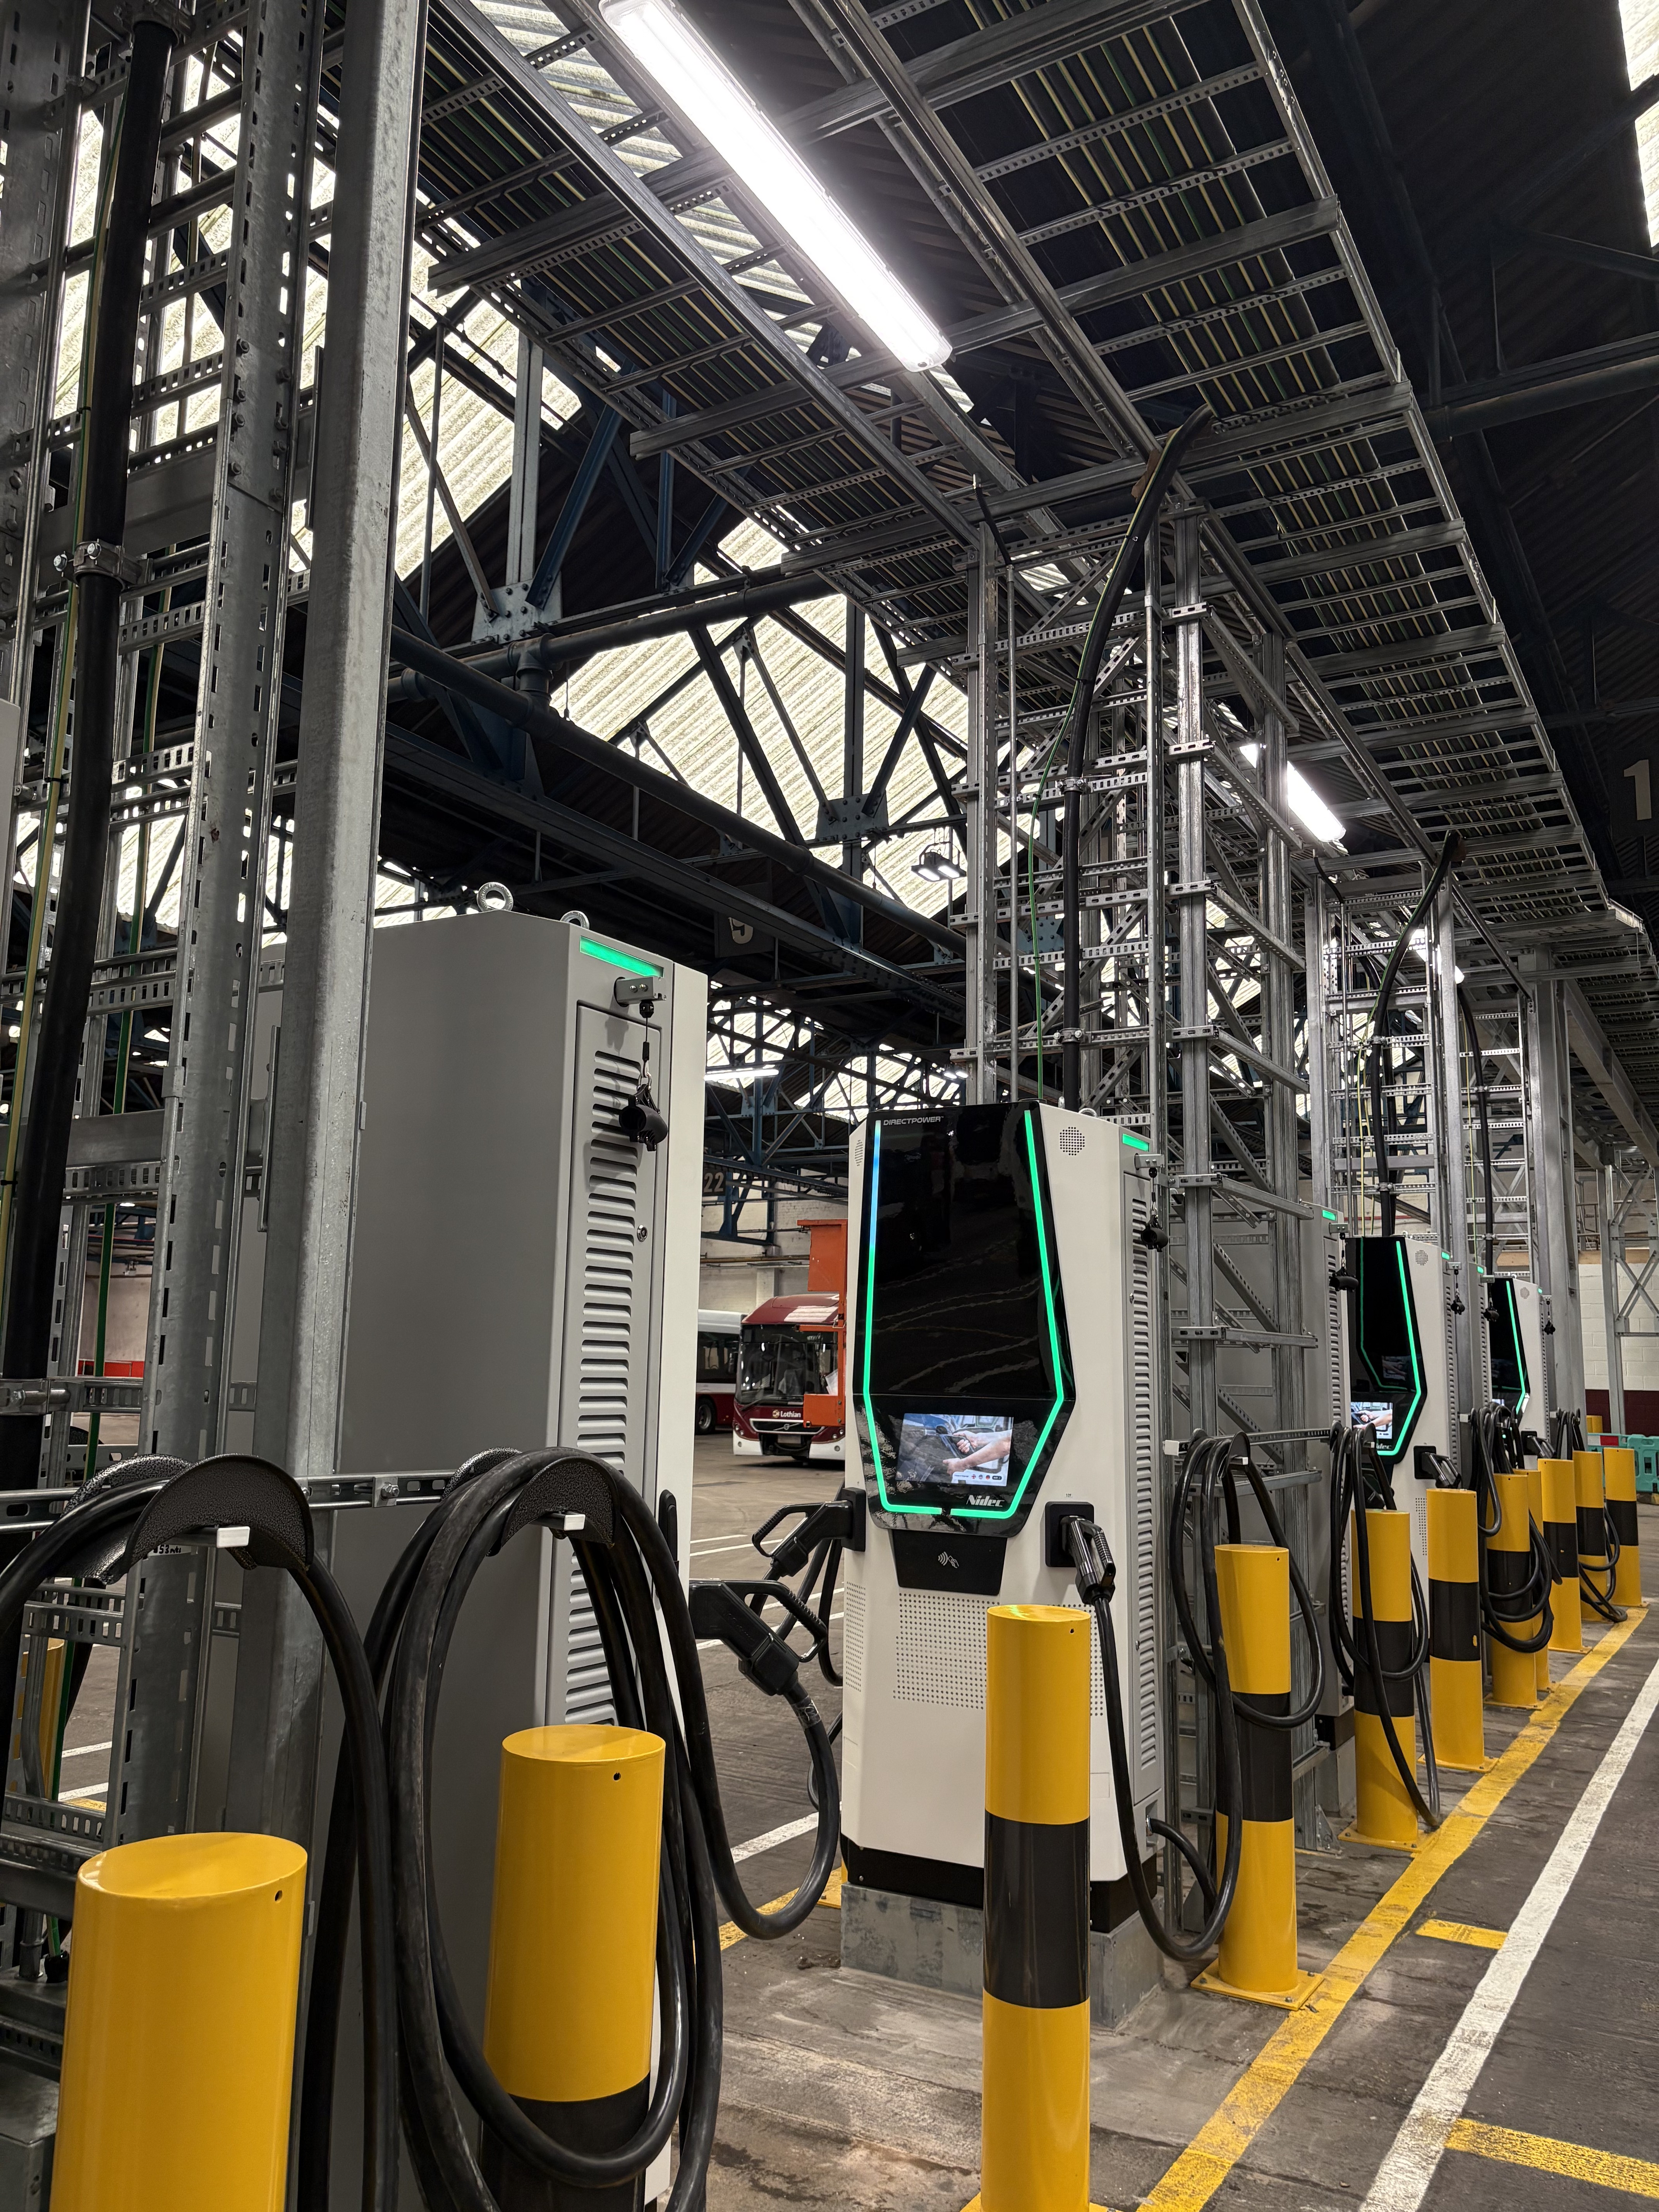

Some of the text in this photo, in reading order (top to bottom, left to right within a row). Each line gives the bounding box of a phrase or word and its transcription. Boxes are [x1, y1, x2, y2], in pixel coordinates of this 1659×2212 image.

[1624, 759, 1652, 821] 1
[704, 1172, 724, 1192] 22
[966, 1495, 1005, 1507] Nidec
